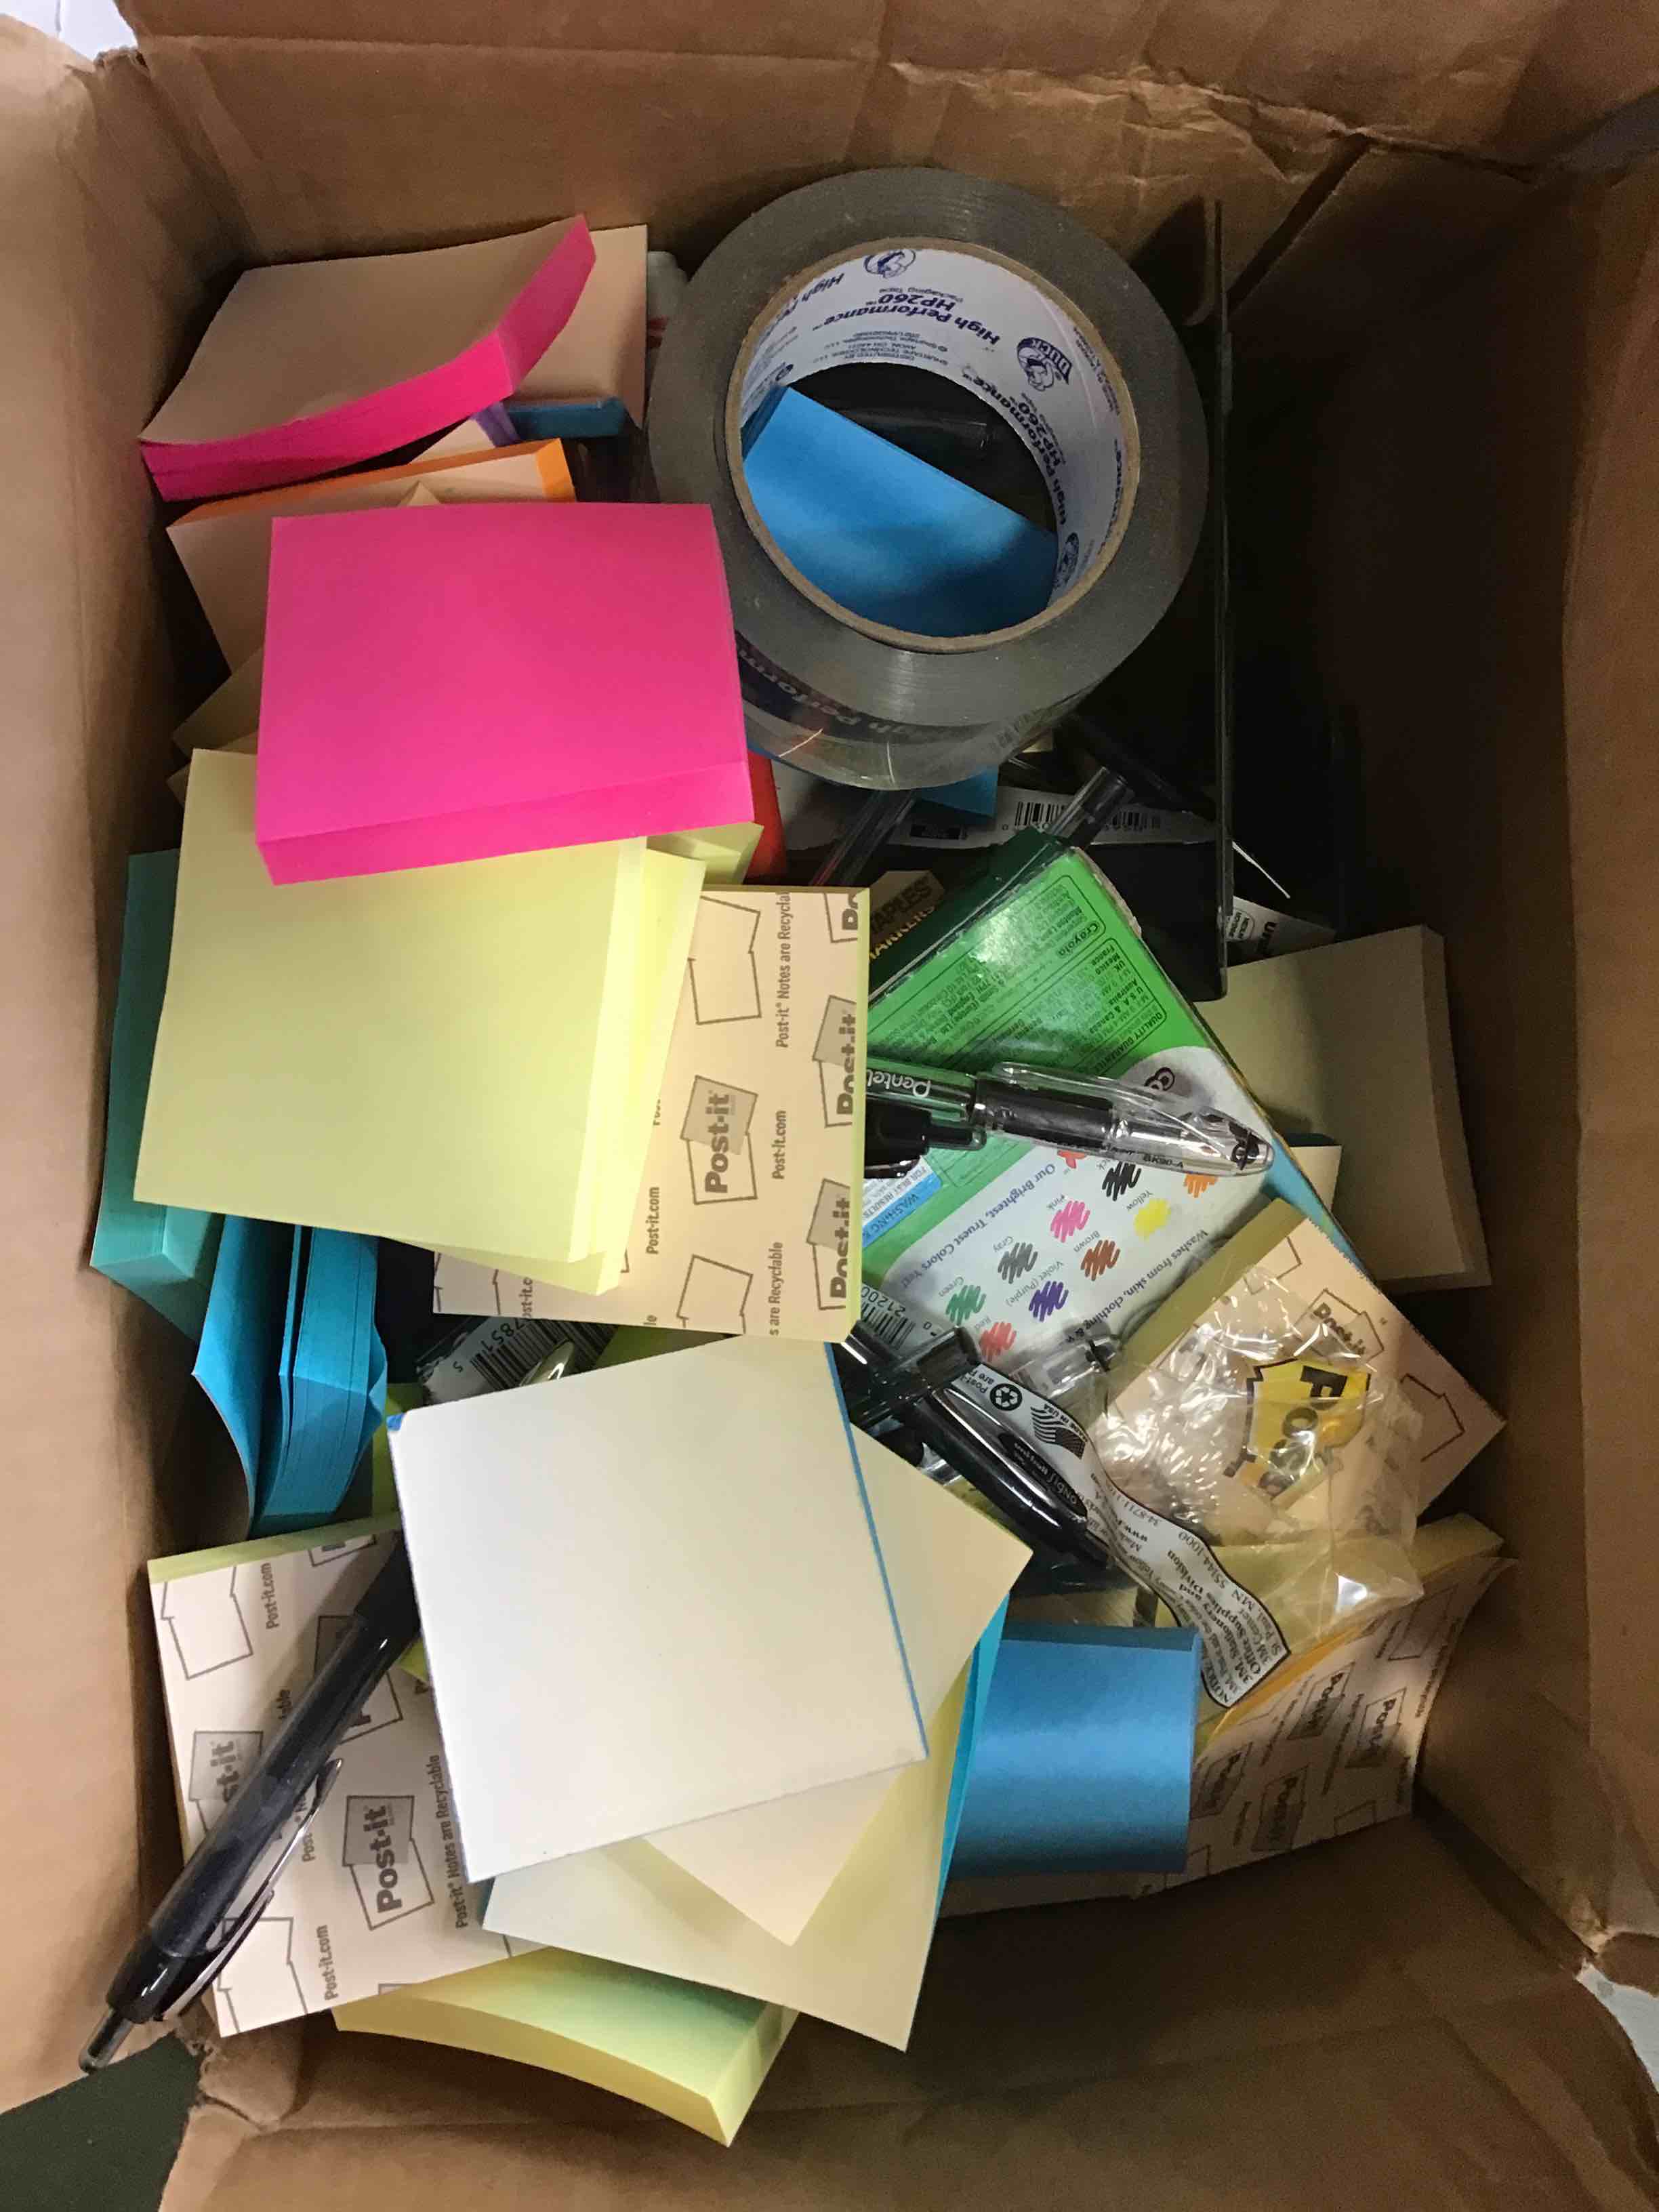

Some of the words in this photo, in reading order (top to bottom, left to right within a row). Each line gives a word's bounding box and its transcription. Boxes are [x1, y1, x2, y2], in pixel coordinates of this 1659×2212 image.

[954, 316, 1001, 344] High
[1029, 339, 1072, 377] DUCK
[777, 891, 794, 940] Recycla
[779, 943, 792, 962] are
[777, 965, 792, 1000] Notes
[867, 1070, 930, 1097] Pentel
[771, 1110, 787, 1180] Post-it.com
[1034, 1164, 1057, 1181] Our
[1046, 1193, 1066, 1210] Pink
[1126, 1189, 1153, 1212] Yellow
[645, 1187, 660, 1255] Post-it.com
[956, 1219, 987, 1246] Truest
[993, 1235, 1015, 1253] Gray
[1073, 1230, 1101, 1253] Brown
[1171, 1229, 1209, 1261] Washes
[920, 1244, 956, 1271] Colors
[1147, 1257, 1173, 1281] from
[768, 1242, 783, 1305] Recyclable
[1038, 1260, 1065, 1284] Violet
[938, 1275, 965, 1297] Green
[770, 1307, 782, 1324] are
[1084, 1296, 1124, 1330] clothing
[1042, 1403, 1061, 1418] USA
[1166, 1549, 1205, 1594] Division
[260, 1563, 281, 1629] Post-it.com
[1178, 1583, 1204, 1601] and
[1231, 1589, 1255, 1611] MN
[426, 1755, 451, 1819] Recyclable
[441, 1821, 455, 1841] are
[363, 1804, 403, 1913] Post-it
[443, 1843, 461, 1879] Notes
[316, 1924, 339, 2001] Post-it.com
